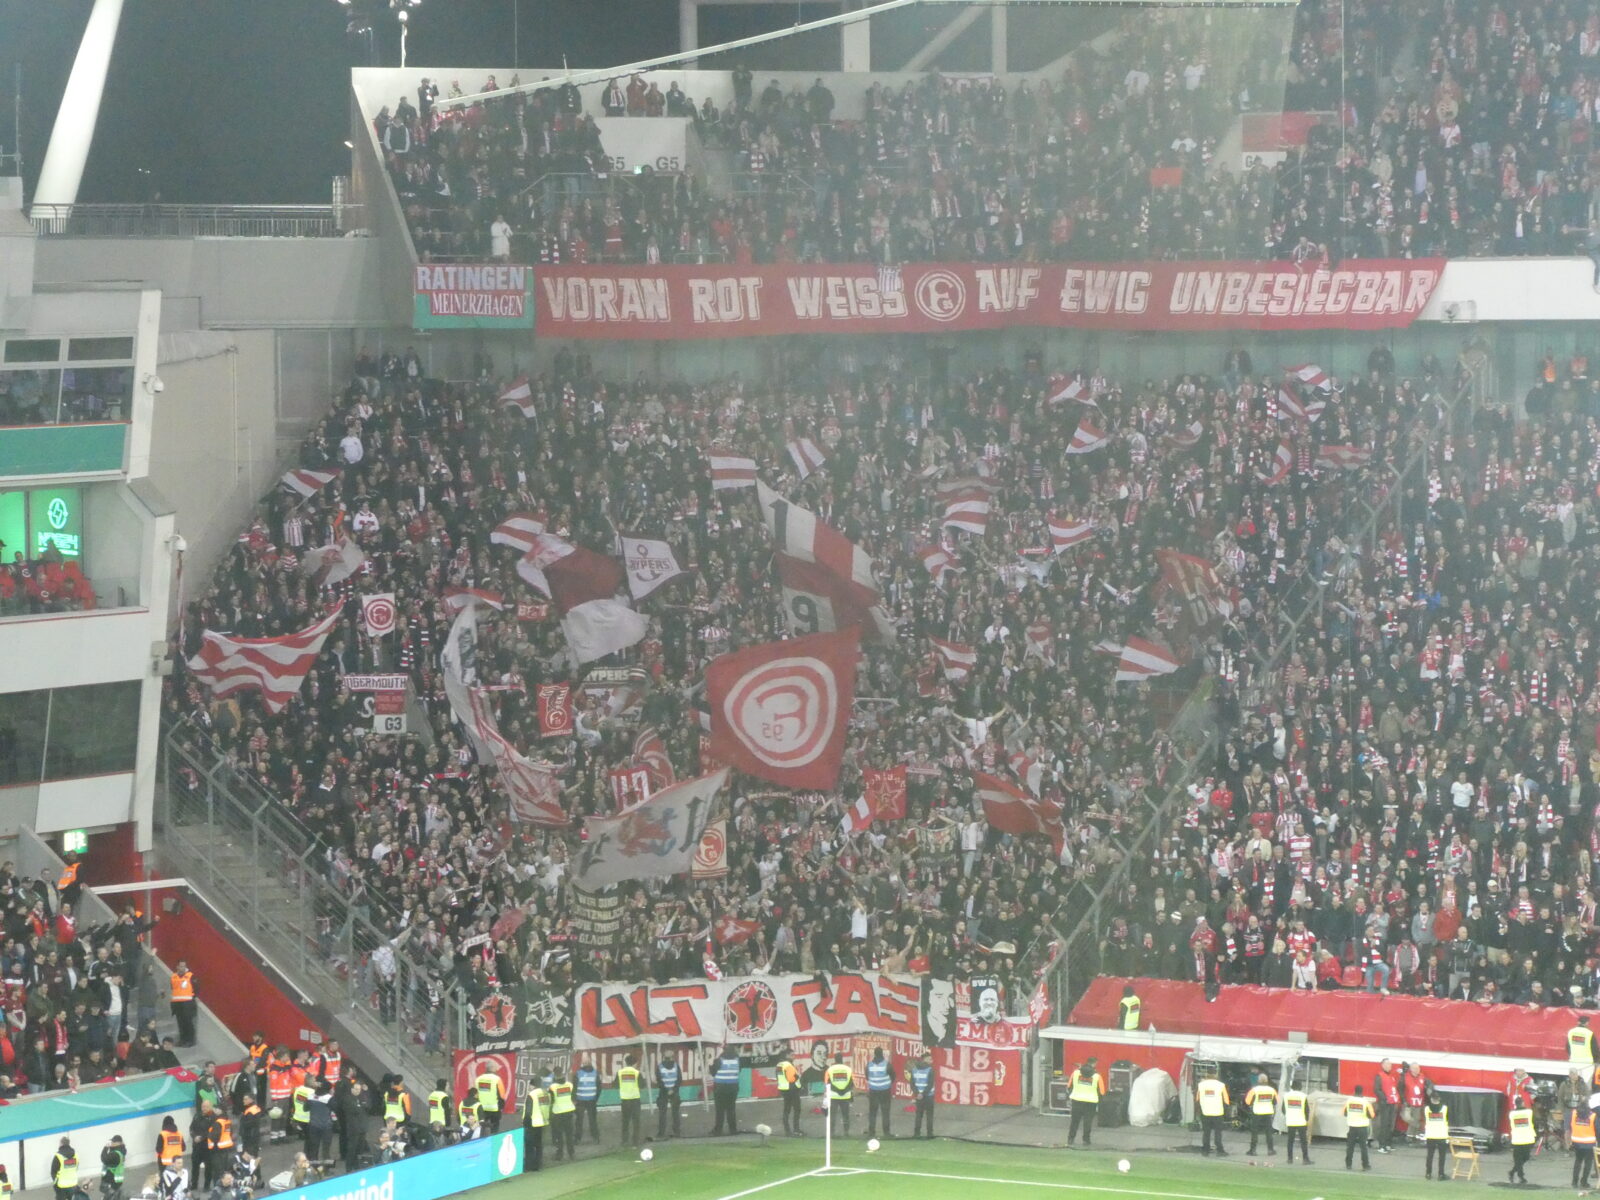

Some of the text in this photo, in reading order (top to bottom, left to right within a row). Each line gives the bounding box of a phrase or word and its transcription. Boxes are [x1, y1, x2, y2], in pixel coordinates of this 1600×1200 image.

[656, 156, 679, 171] G5
[416, 266, 524, 290] RATINGEN
[432, 292, 524, 316] MEINERZHAGEN
[542, 276, 670, 323] VORAN
[688, 277, 763, 323] ROT
[786, 272, 908, 321] WEISS
[975, 268, 1042, 312] AUF
[1060, 268, 1151, 314] EWIG
[1169, 269, 1438, 316] UNBESIEGBAR
[384, 717, 402, 731] G3
